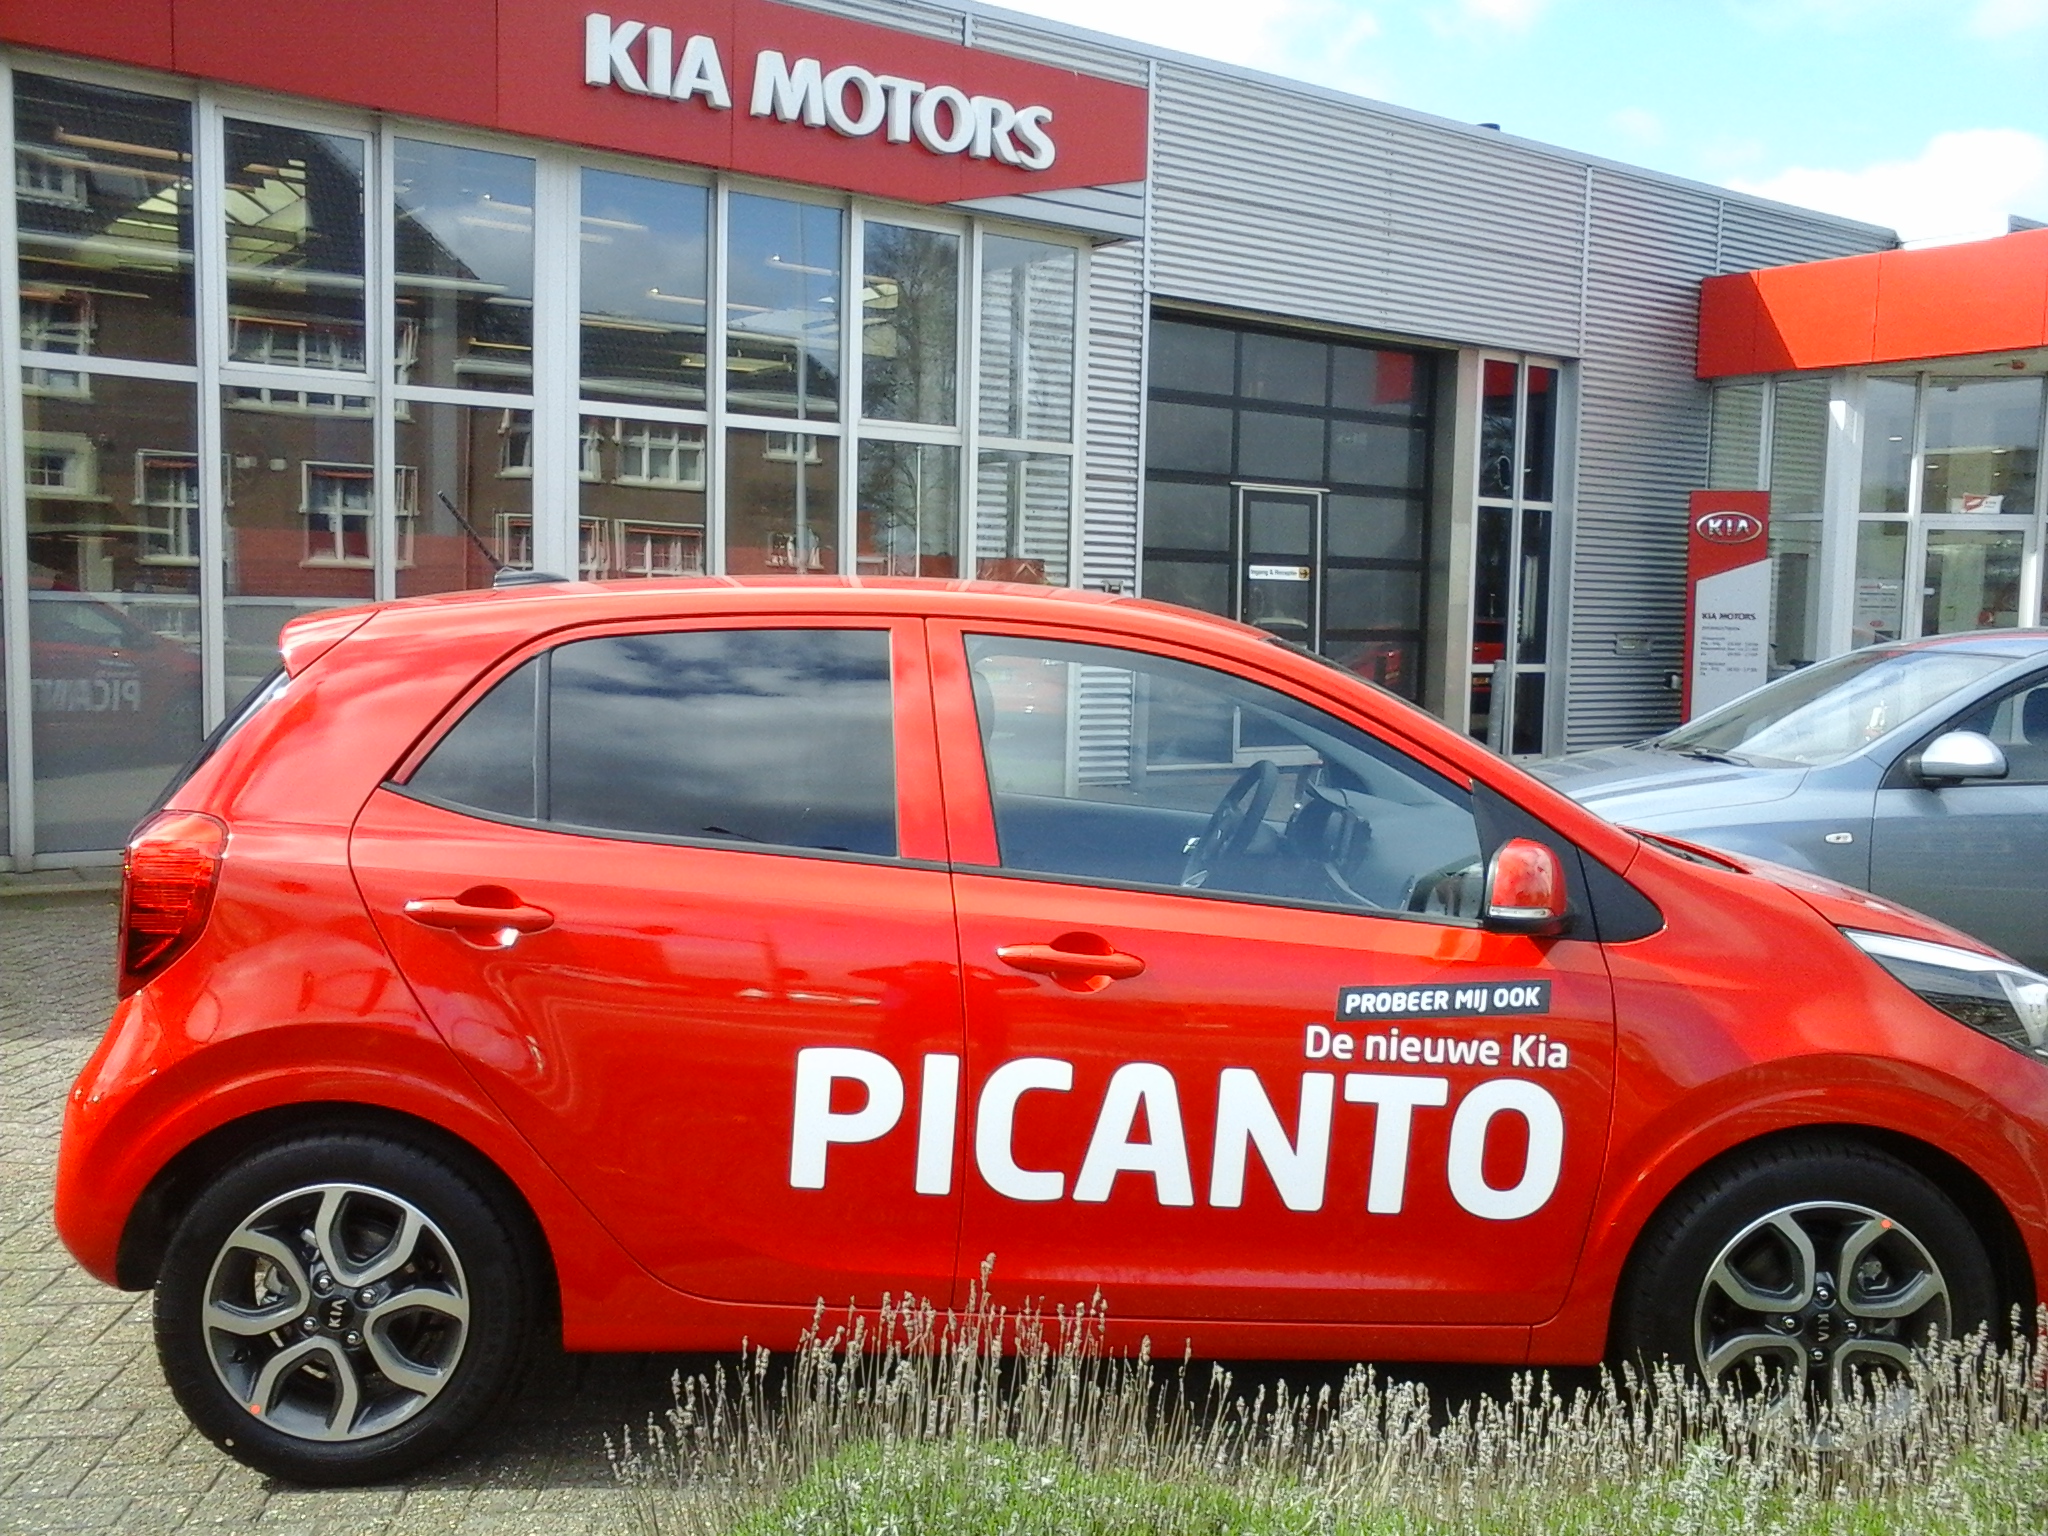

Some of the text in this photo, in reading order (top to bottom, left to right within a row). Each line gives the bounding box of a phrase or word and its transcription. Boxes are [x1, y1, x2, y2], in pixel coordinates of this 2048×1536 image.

[585, 13, 1057, 171] KIA MOTORS
[1708, 518, 1751, 537] KIA
[1345, 986, 1541, 1014] PROBEER MIJ OOK
[1304, 1024, 1569, 1069] De nieuwe Kia
[789, 1047, 1565, 1220] PICANTO
[328, 1299, 347, 1327] KIA
[1817, 1313, 1830, 1341] KIA
